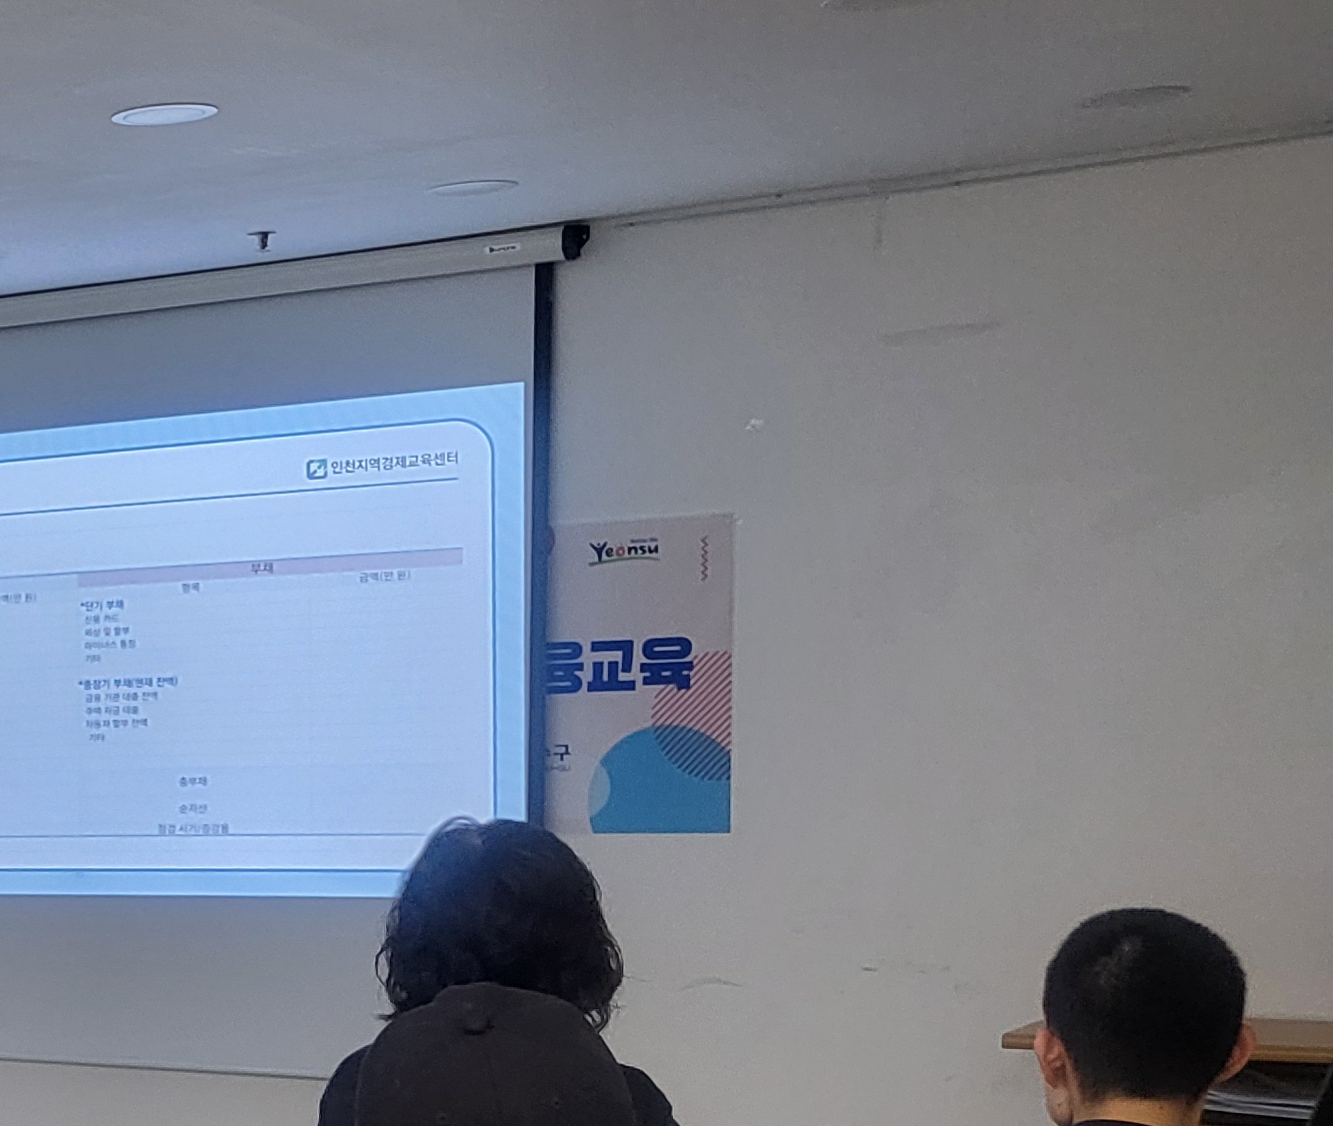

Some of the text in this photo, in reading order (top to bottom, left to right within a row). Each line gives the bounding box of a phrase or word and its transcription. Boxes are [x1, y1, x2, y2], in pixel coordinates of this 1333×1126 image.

[331, 450, 459, 475] 인천지역경제교육센터
[589, 541, 659, 562] Yeonsu
[251, 562, 274, 574] 부채
